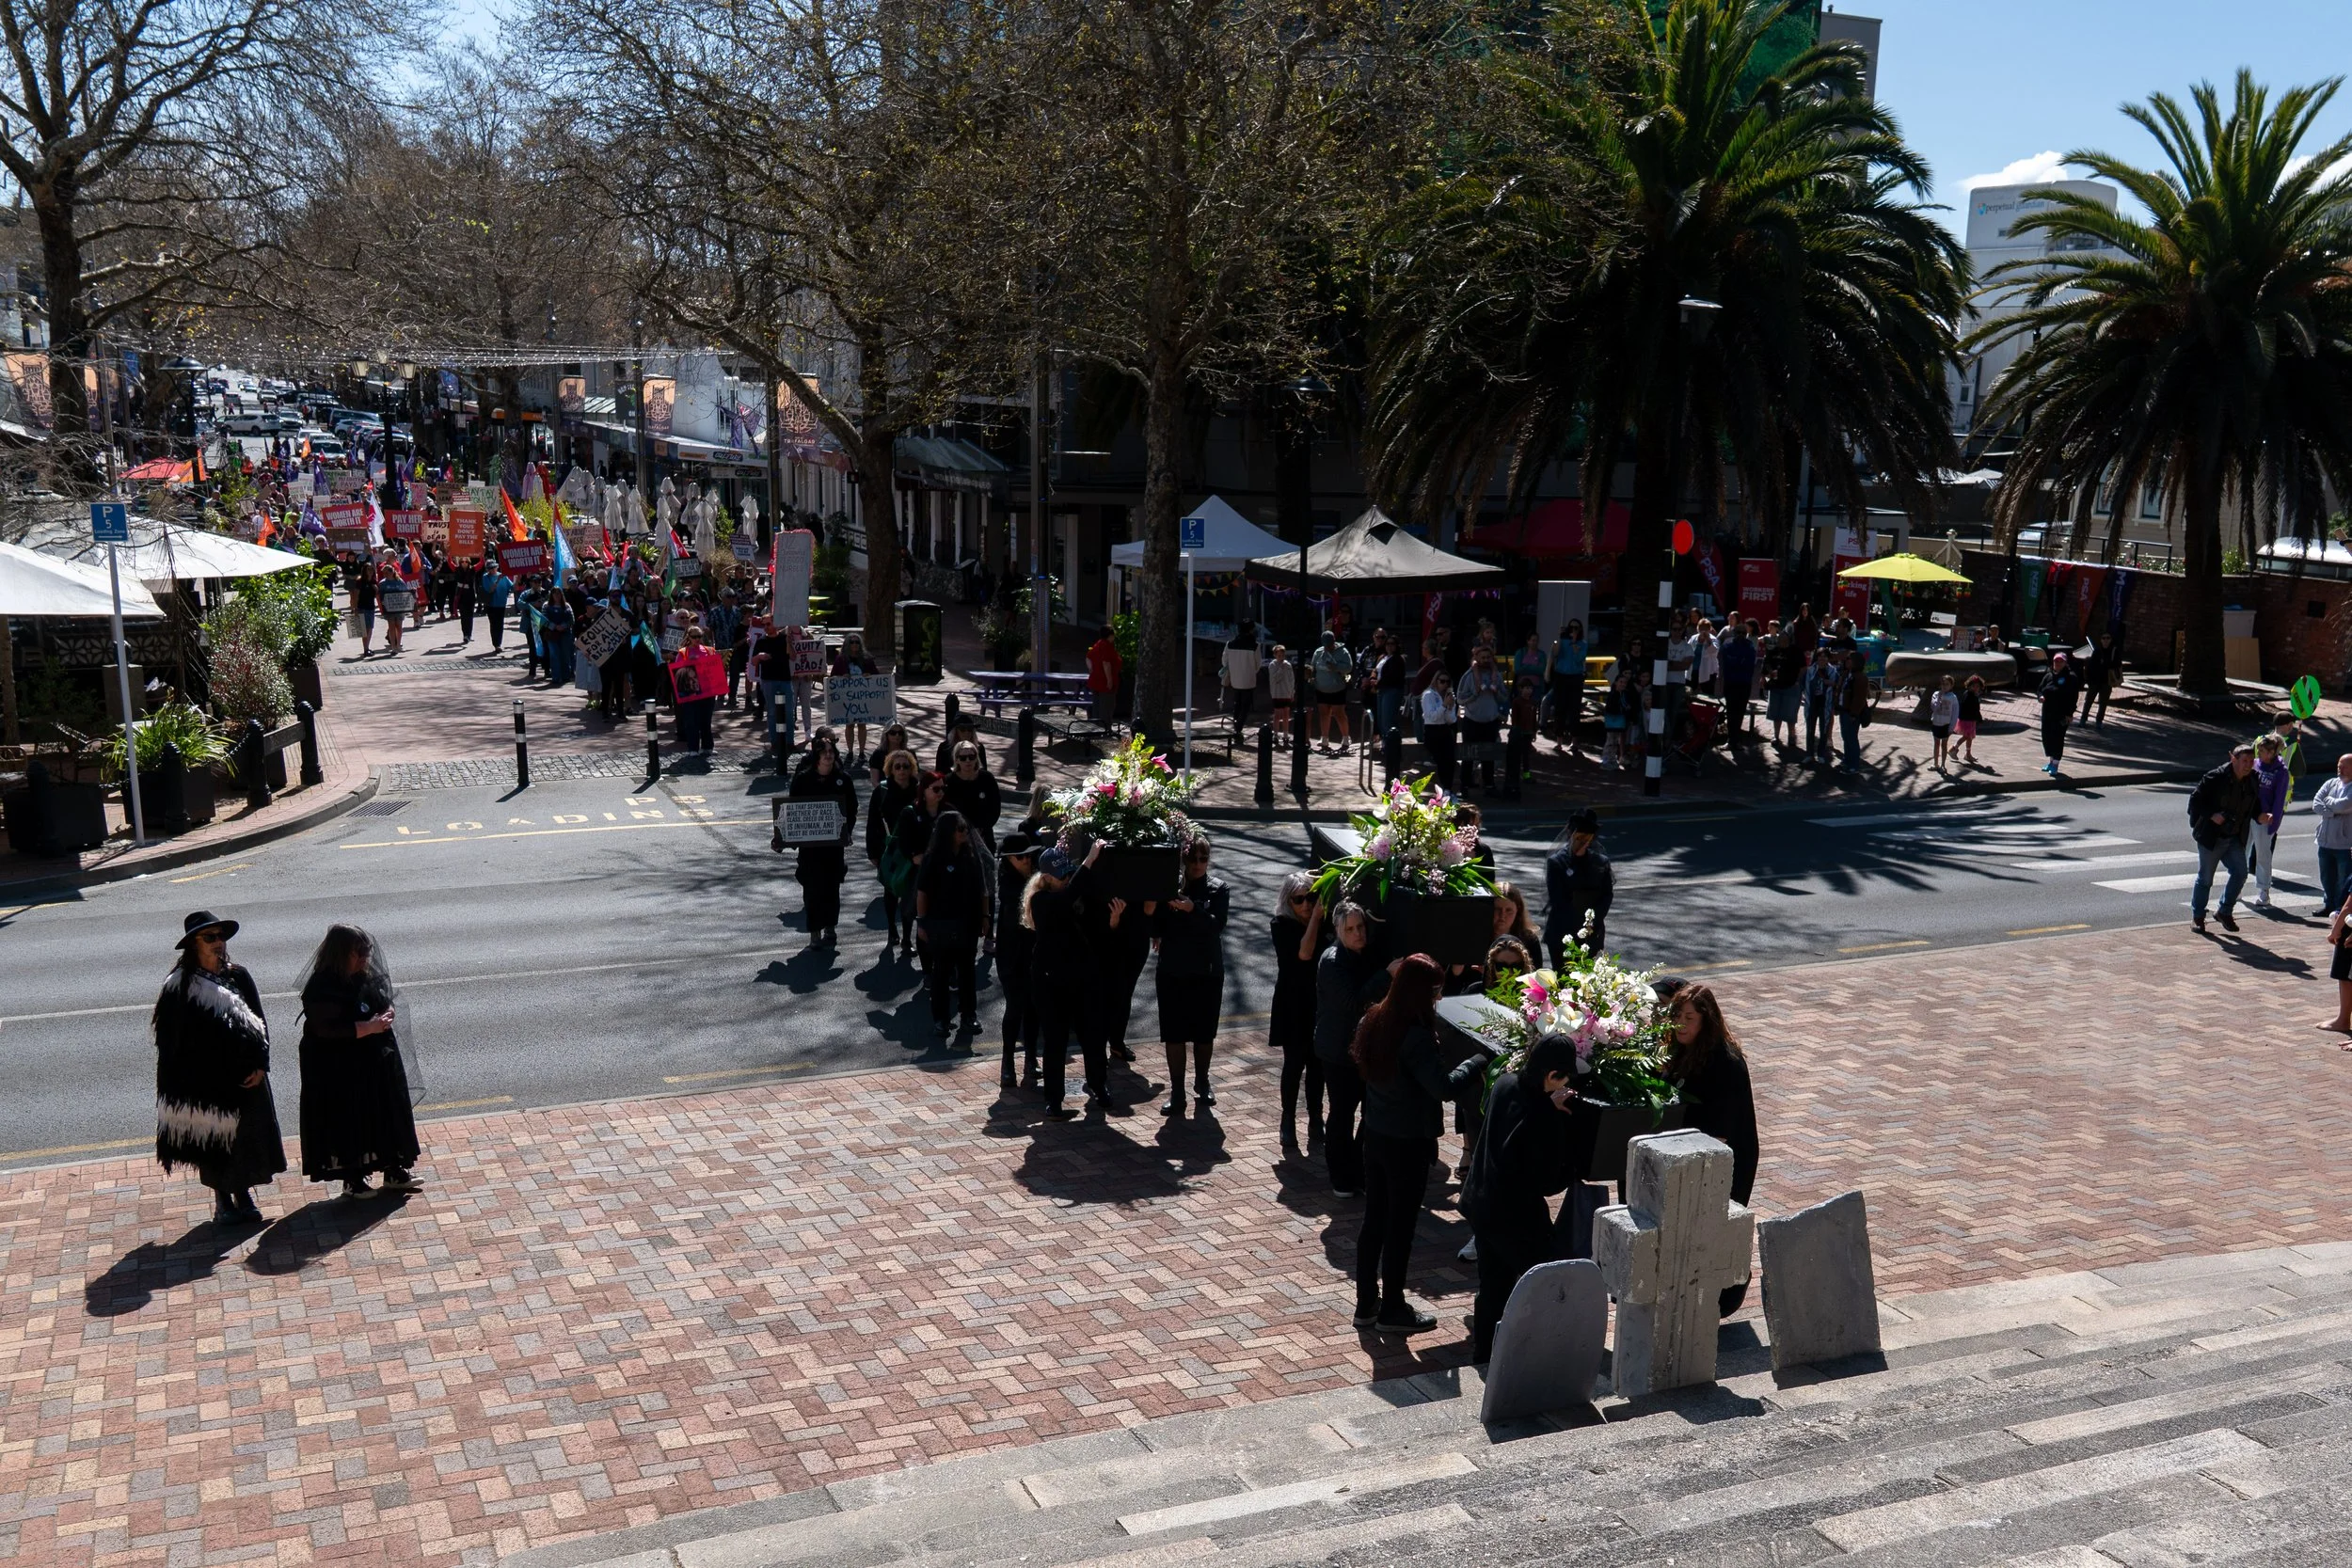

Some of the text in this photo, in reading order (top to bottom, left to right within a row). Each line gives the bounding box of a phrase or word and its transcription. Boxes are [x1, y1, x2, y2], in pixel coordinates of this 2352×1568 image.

[1986, 201, 2015, 214] perpetual
[103, 506, 113, 517] P
[326, 510, 351, 520] WOMEN
[105, 519, 112, 529] 5
[331, 518, 355, 527] WORTH
[392, 515, 422, 524] PAY HER
[1189, 520, 1197, 530] P
[397, 524, 419, 533] RIGHT
[501, 546, 543, 560] WOMEN ARE
[508, 556, 540, 568] WORTH IT
[1700, 557, 1720, 587] PSA
[2080, 577, 2090, 602] PSA
[1742, 593, 1774, 601] FIRST
[580, 609, 615, 645] EQUITY
[586, 641, 601, 656] FOR
[793, 641, 821, 652] QUITY
[592, 649, 608, 661] BIG
[794, 658, 822, 671] DEAD!
[829, 677, 888, 689] SUPPORT US
[829, 689, 888, 703] TO SUPPORT
[843, 703, 868, 717] YOU
[624, 795, 707, 807] P 5
[397, 809, 714, 835] LOADING
